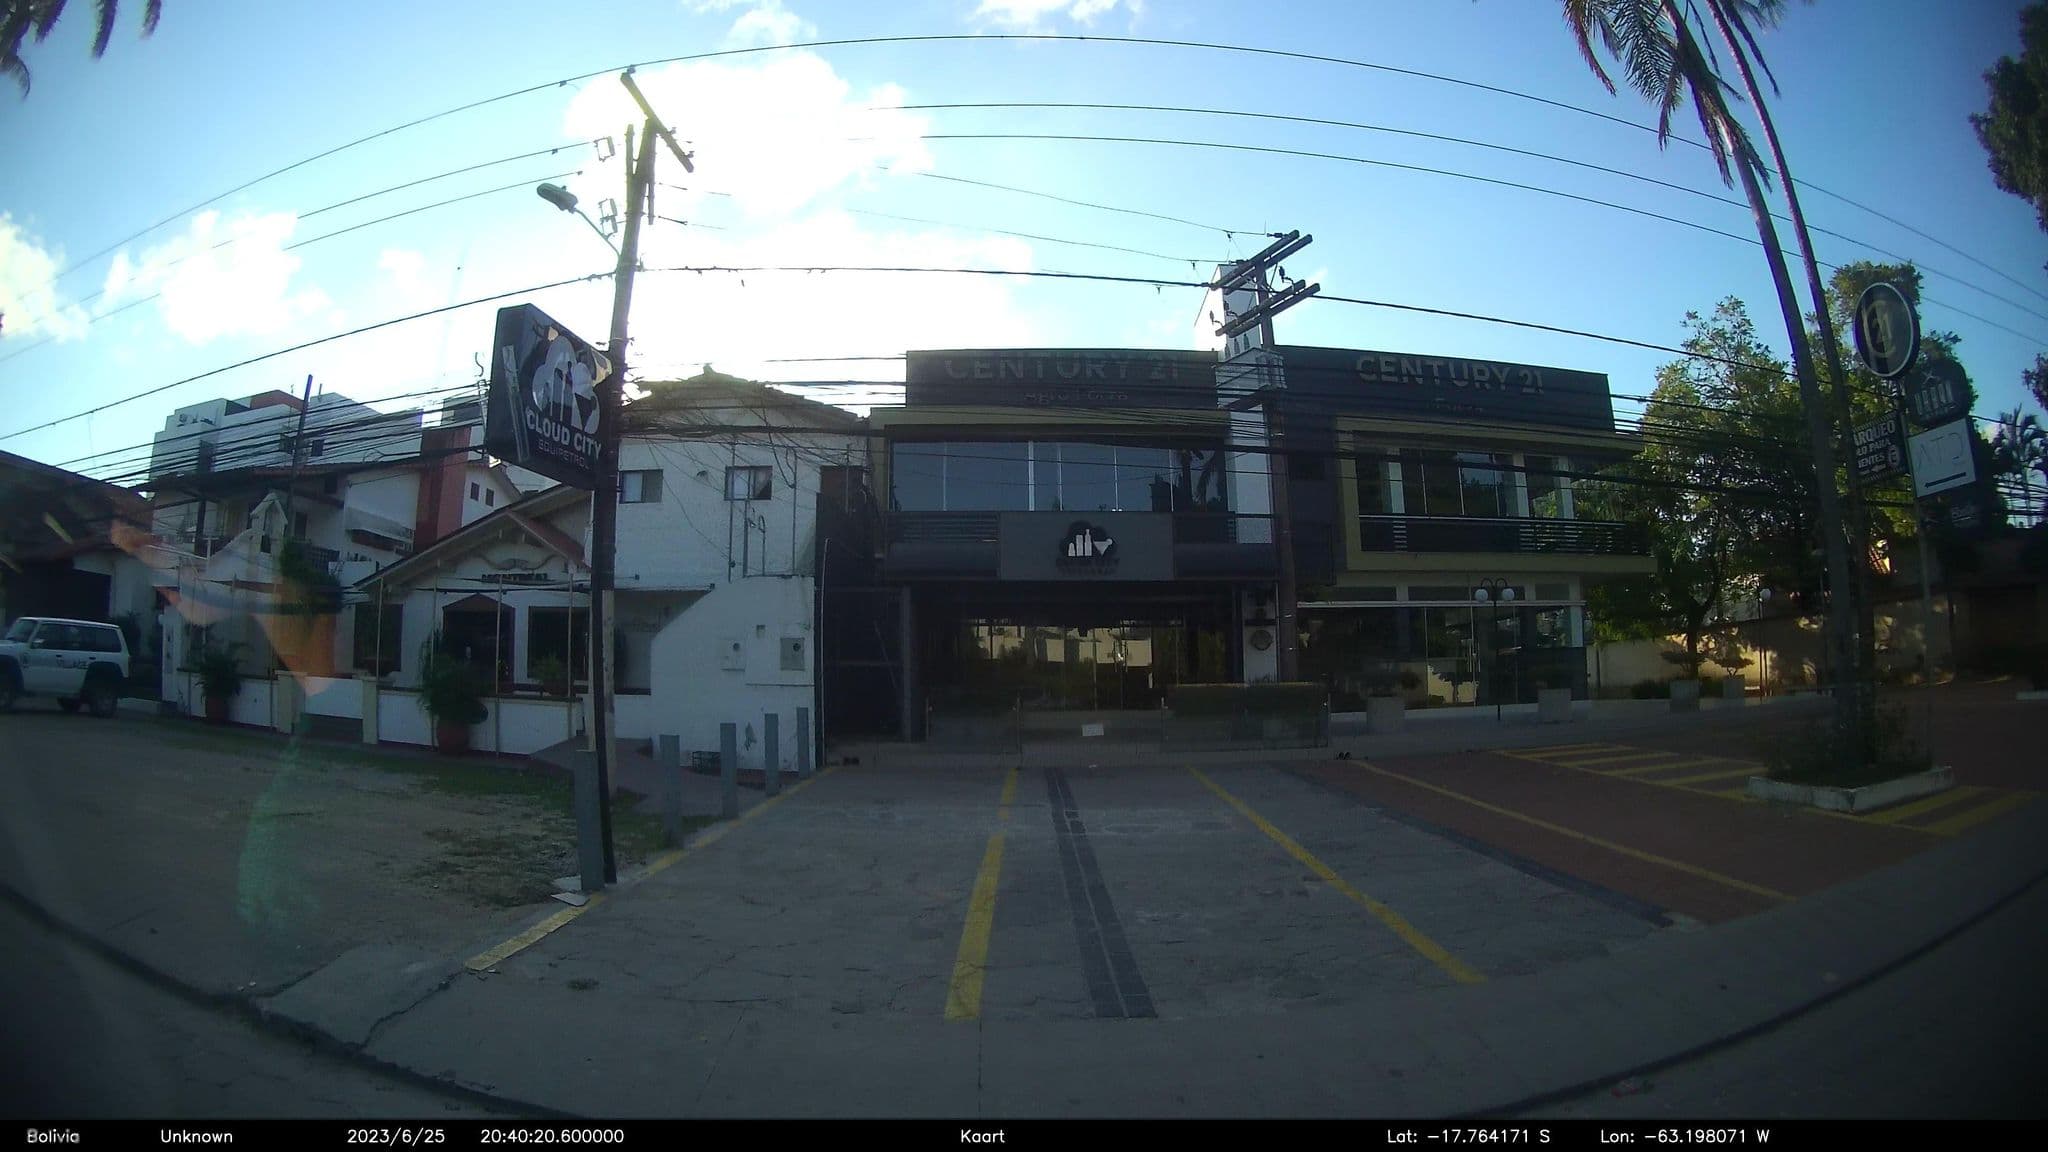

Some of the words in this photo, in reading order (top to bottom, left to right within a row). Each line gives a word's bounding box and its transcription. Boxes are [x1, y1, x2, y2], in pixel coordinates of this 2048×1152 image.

[945, 352, 1129, 380] CENTURY
[1356, 355, 1511, 392] CENTURY
[1517, 367, 1544, 394] 21
[525, 406, 571, 446] CLOUD
[573, 432, 602, 461] CITY
